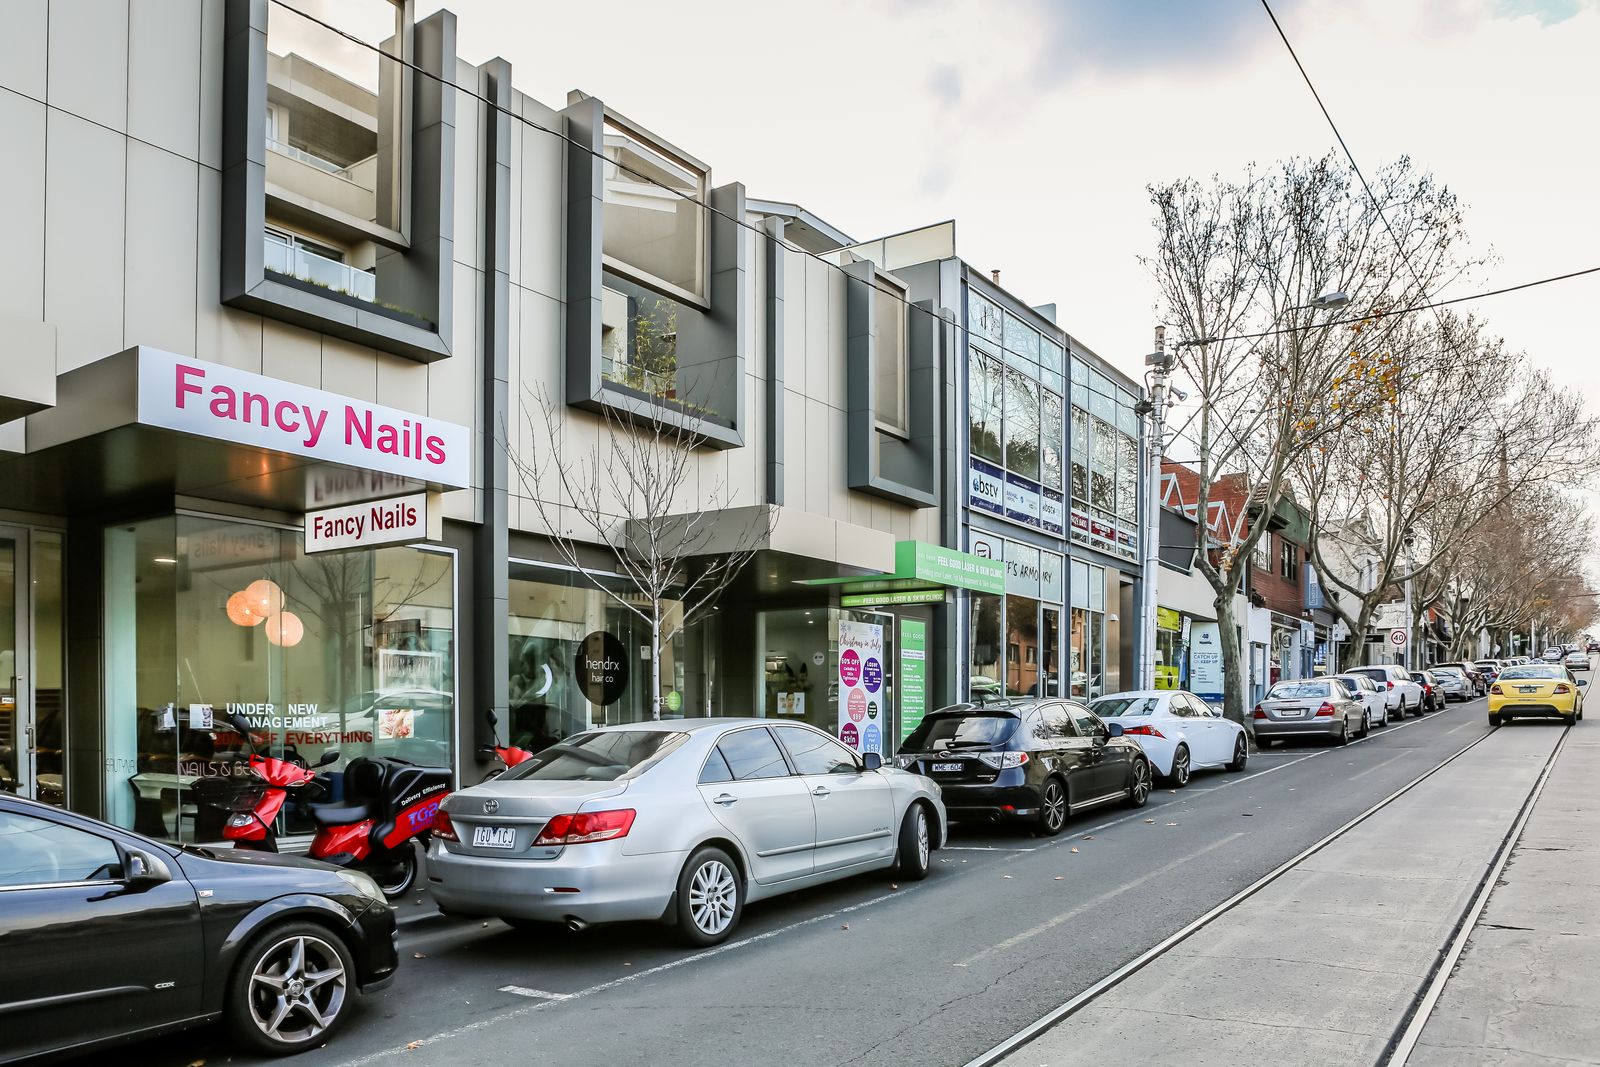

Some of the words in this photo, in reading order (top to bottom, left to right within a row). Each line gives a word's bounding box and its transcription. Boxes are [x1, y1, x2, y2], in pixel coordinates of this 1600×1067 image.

[175, 363, 329, 448] Fancy
[344, 405, 447, 465] Nails
[314, 515, 366, 540] Fancy
[371, 503, 417, 532] Nails
[937, 556, 949, 567] FEEL
[949, 558, 961, 570] GOOD
[961, 561, 976, 573] LASER
[979, 566, 989, 576] SKIN
[989, 568, 1003, 578] CLINIC
[890, 595, 906, 603] LASER
[912, 594, 925, 602] SKIN
[925, 593, 943, 601] CLINIC
[1393, 633, 1404, 641] 40
[585, 655, 620, 671] hendrx
[591, 673, 604, 682] hair
[605, 675, 614, 683] co
[226, 703, 274, 715] UNDER
[288, 703, 318, 715] NEW
[243, 716, 328, 728] ANAGEMENT
[285, 731, 373, 745] EVERYTHING
[843, 735, 856, 743] Skin
[179, 762, 218, 777] NAILS
[220, 761, 231, 776] &
[401, 792, 421, 806] Delivery
[422, 783, 446, 795] Efficiency
[154, 981, 175, 989] CDX
